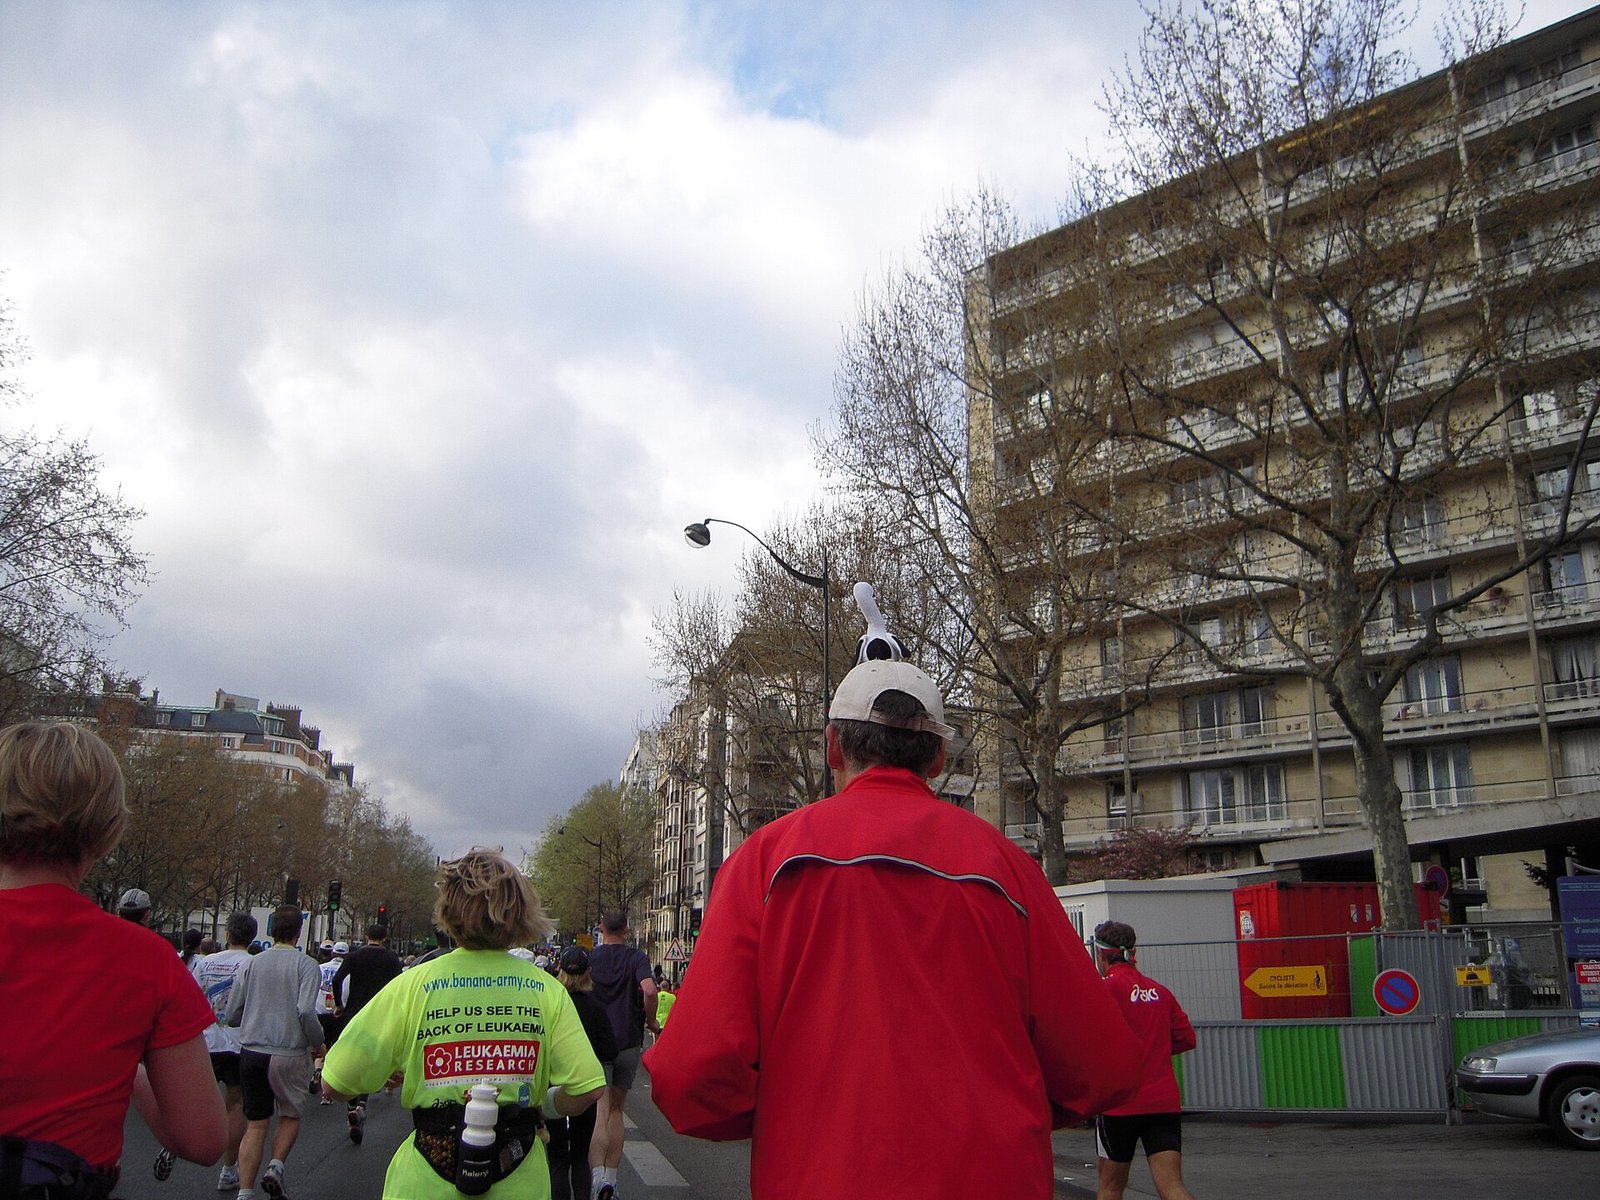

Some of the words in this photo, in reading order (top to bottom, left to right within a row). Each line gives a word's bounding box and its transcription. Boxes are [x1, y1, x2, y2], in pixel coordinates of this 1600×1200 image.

[424, 973, 545, 993] www.banana-army.com
[426, 1007, 461, 1021] HELP
[464, 1006, 483, 1017] US
[486, 1006, 513, 1016] SEE
[516, 1006, 540, 1018] THE
[417, 1024, 452, 1041] BACK
[454, 1023, 473, 1034] OF
[477, 1022, 546, 1037] LEUKAEMIA
[454, 1045, 536, 1060] LEUKAEMIA
[454, 1060, 535, 1073] RESEARCH
